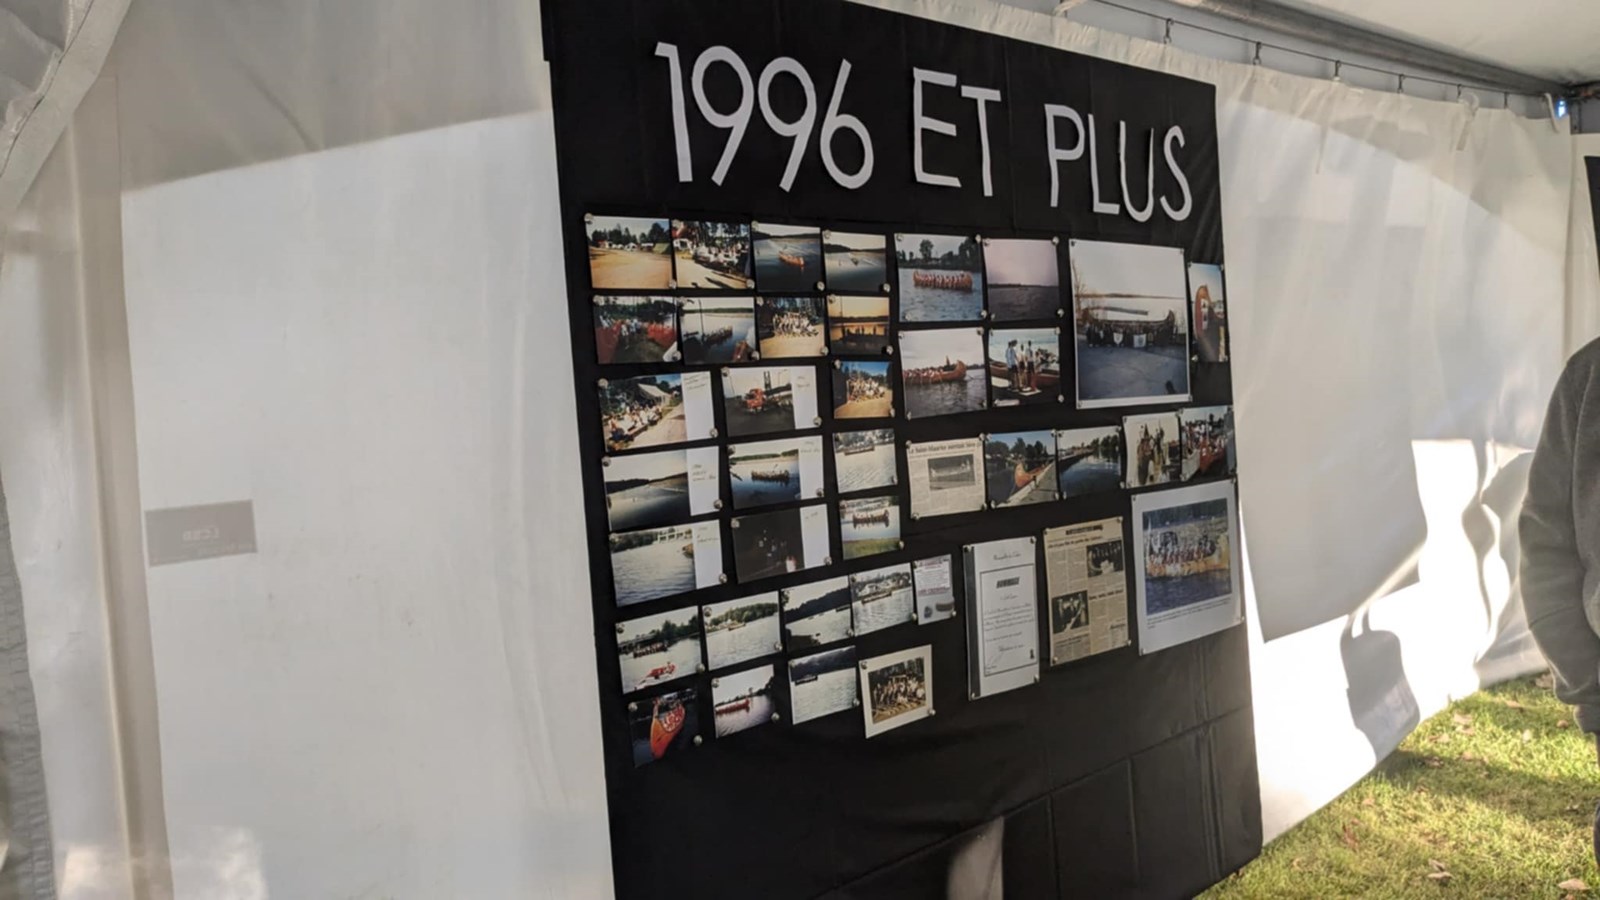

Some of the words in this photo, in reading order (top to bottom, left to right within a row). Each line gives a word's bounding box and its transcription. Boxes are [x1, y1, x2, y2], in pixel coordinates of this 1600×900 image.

[654, 42, 874, 192] 1996
[912, 68, 1001, 198] ET
[1045, 104, 1194, 222] PLUS
